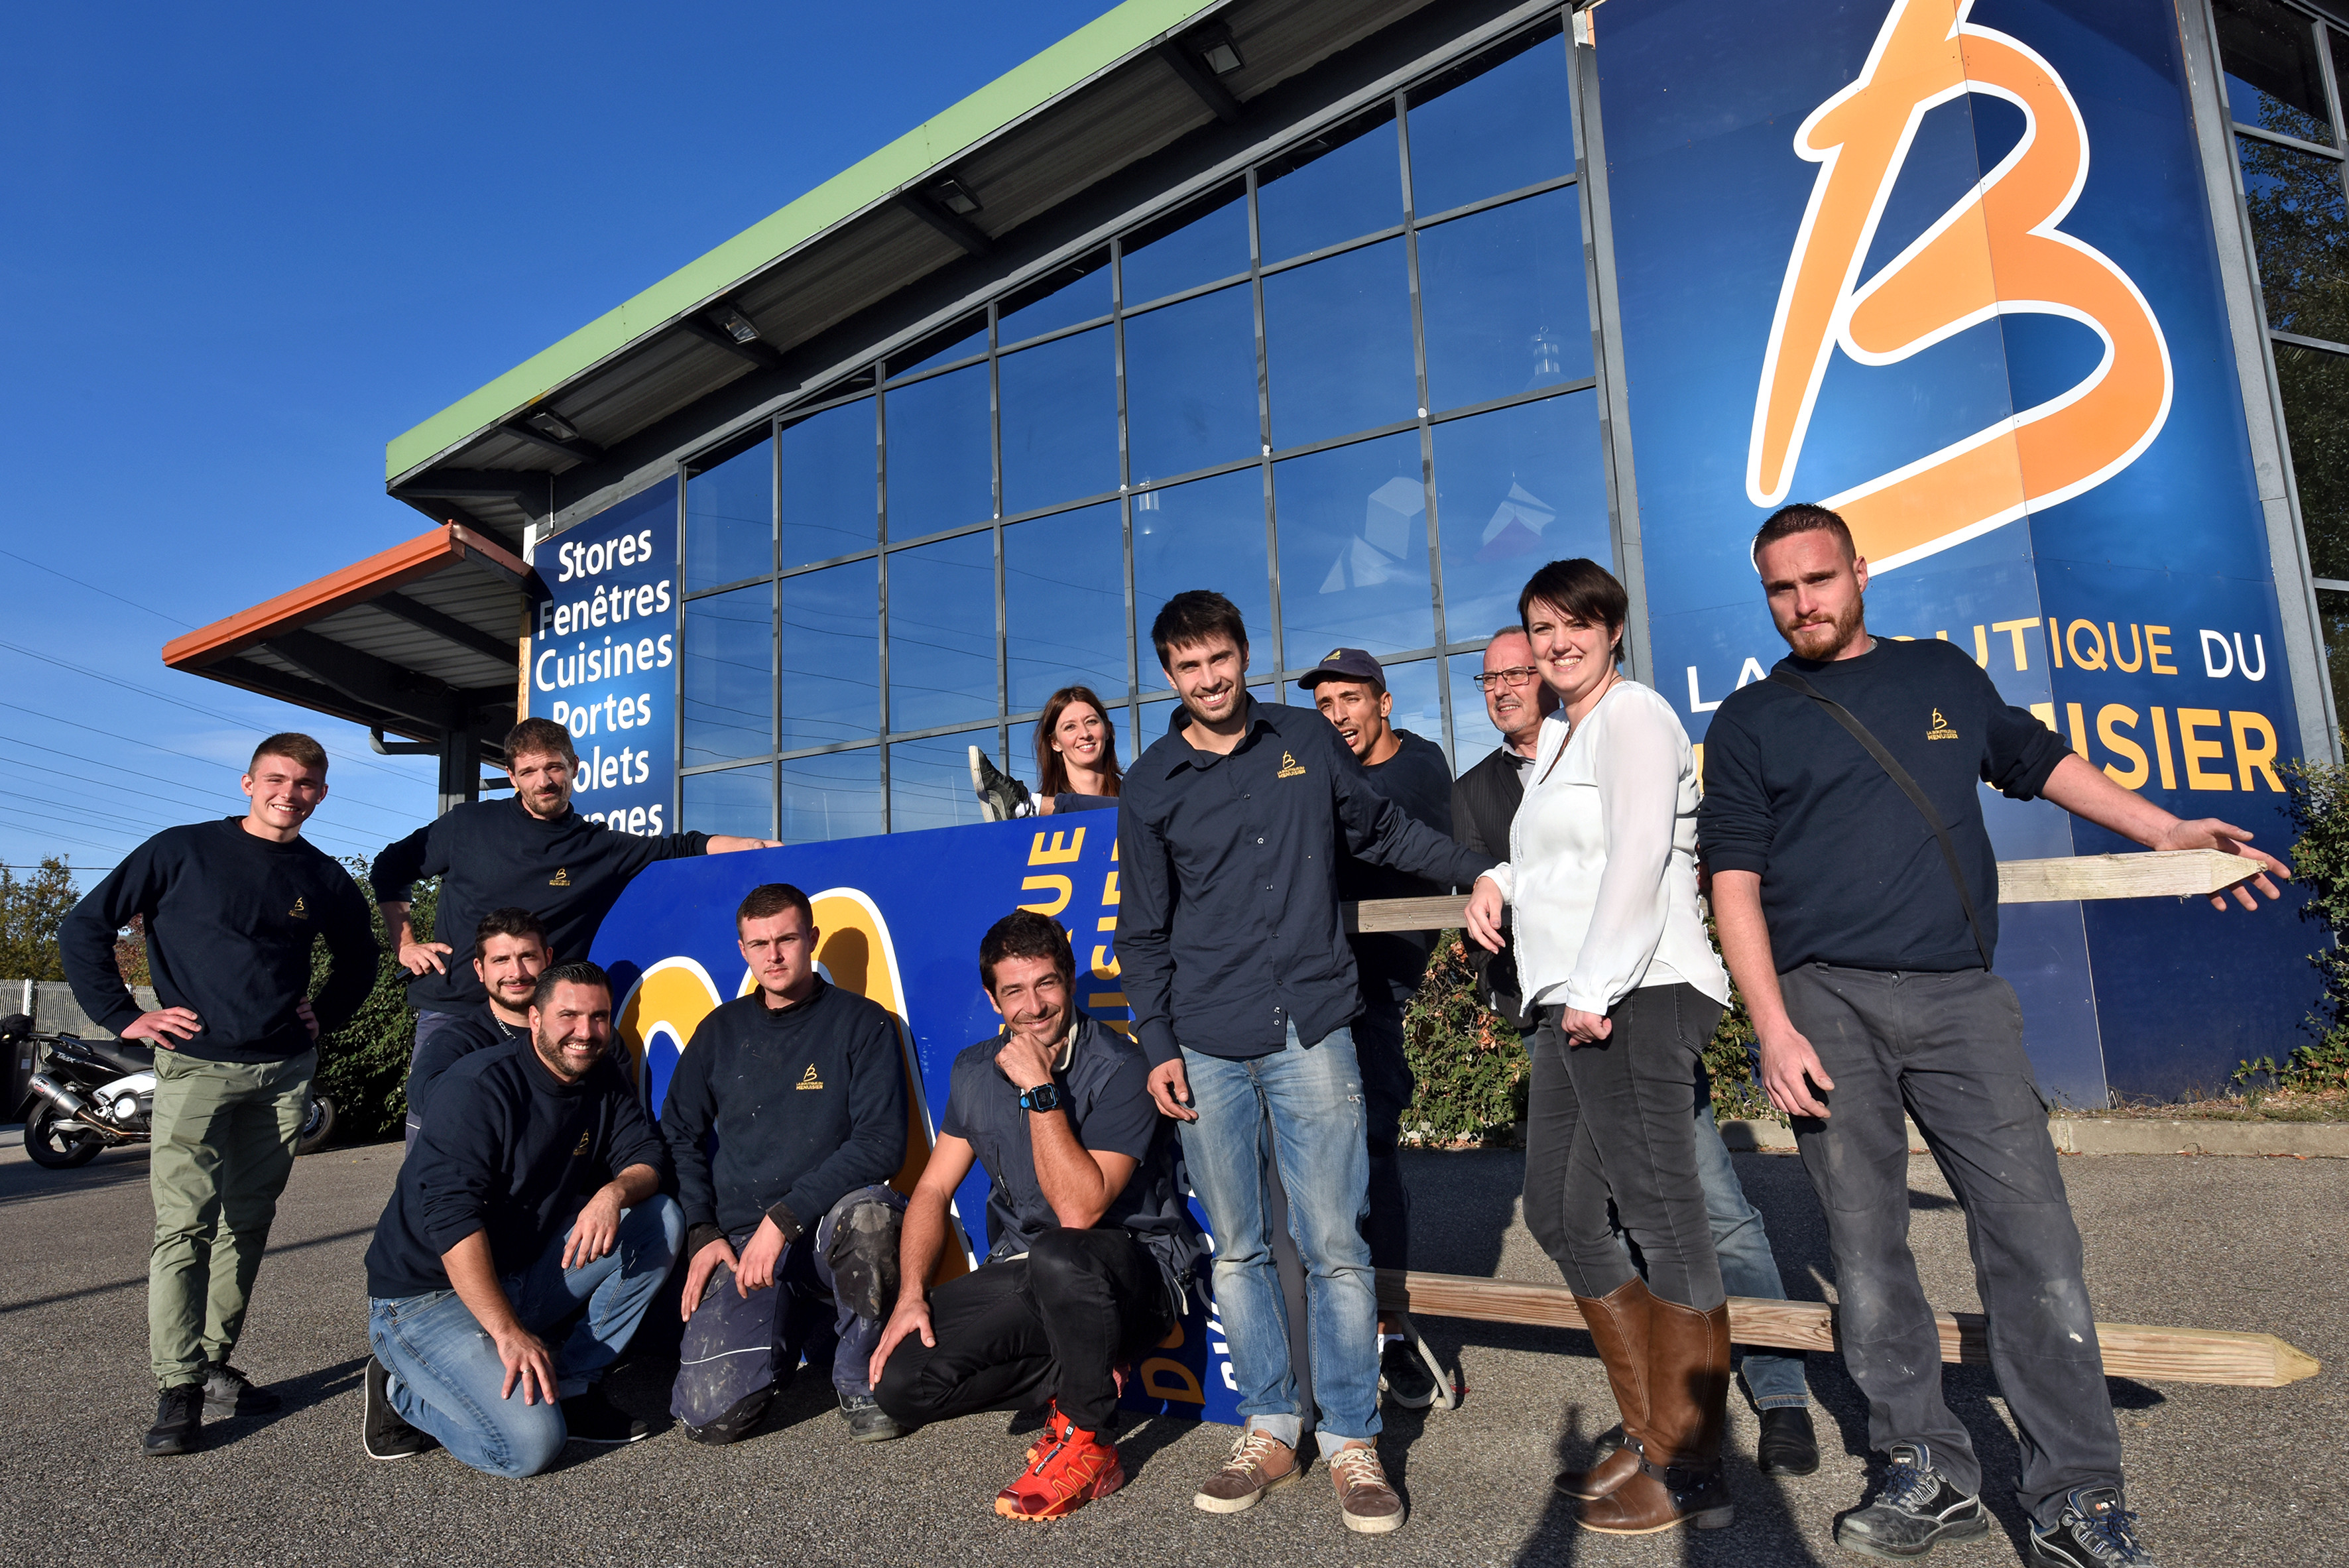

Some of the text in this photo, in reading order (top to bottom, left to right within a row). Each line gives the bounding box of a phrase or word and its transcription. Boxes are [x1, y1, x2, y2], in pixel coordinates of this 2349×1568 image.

[558, 529, 652, 583] Stores
[538, 579, 671, 641] Fenêtres
[535, 633, 673, 692] Cuisines
[1890, 617, 2179, 675] TIQUE
[2199, 629, 2266, 682] DU
[552, 693, 652, 739] Portes
[572, 746, 649, 794] olets
